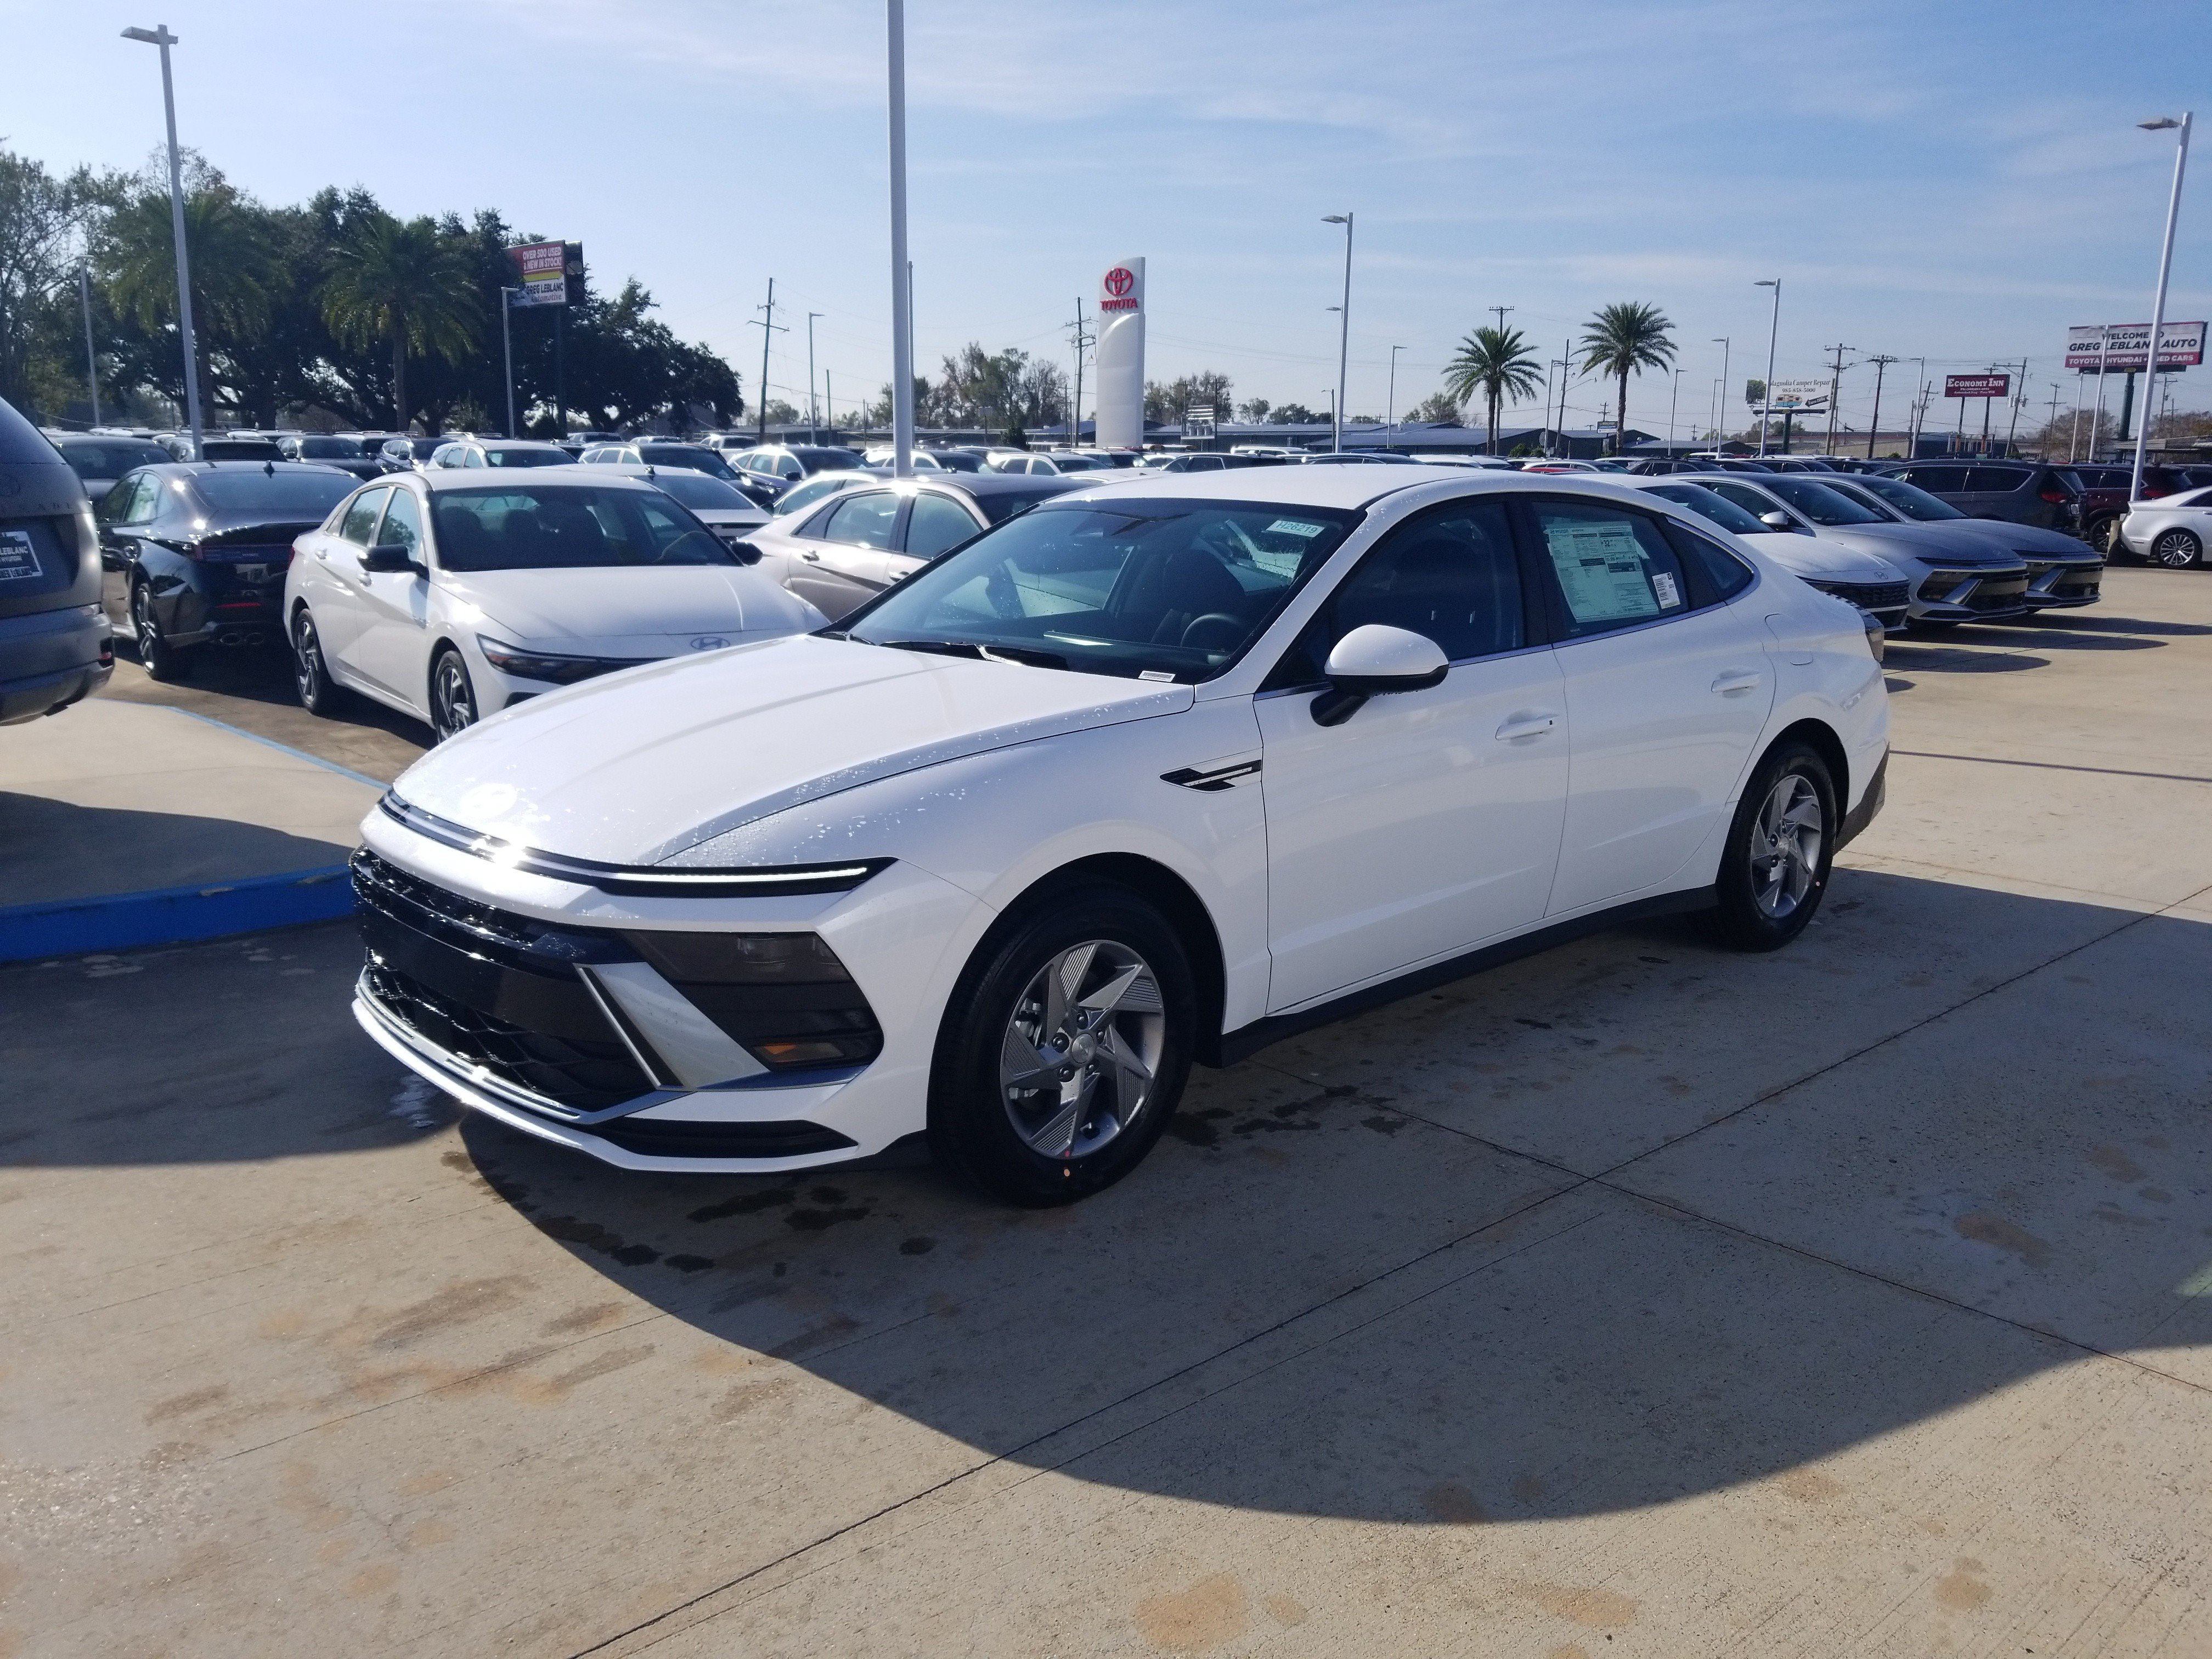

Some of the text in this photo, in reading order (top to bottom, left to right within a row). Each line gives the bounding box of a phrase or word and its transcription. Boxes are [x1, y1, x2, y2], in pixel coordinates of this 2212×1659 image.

[523, 250, 536, 260] OVER
[548, 247, 561, 256] USED
[527, 259, 538, 269] NEW
[539, 258, 544, 268] IN
[541, 281, 563, 293] LEBLANC
[1100, 298, 1138, 310] TOYOTA
[2069, 342, 2101, 351] GREG
[2160, 338, 2197, 348] AUTO
[1276, 521, 1318, 533] H26219
